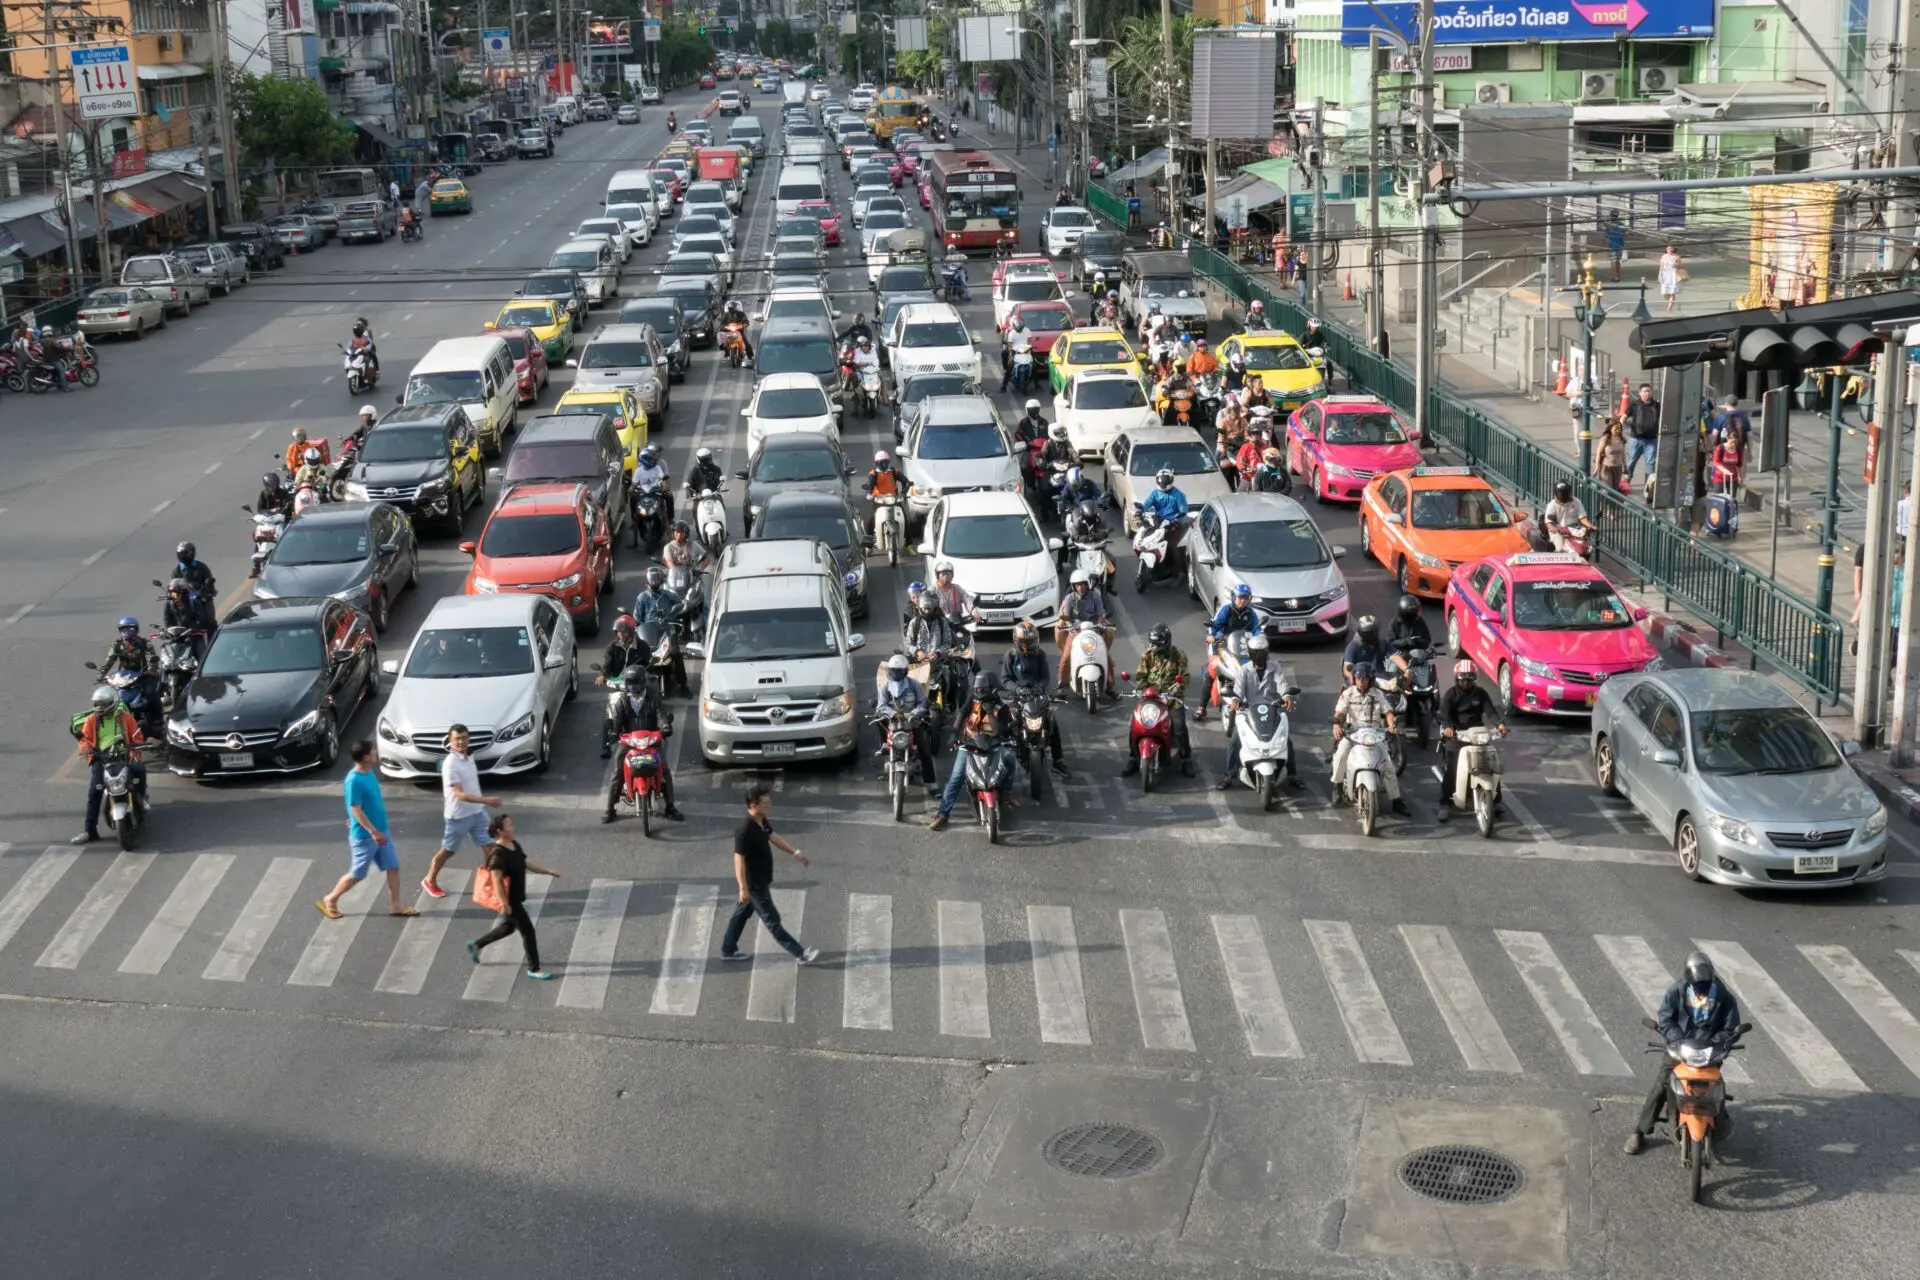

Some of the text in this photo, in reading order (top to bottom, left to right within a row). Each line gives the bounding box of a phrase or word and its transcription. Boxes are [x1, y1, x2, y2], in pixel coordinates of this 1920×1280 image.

[1518, 7, 1569, 26] ได้เลย
[1593, 4, 1629, 24] ทางนี้
